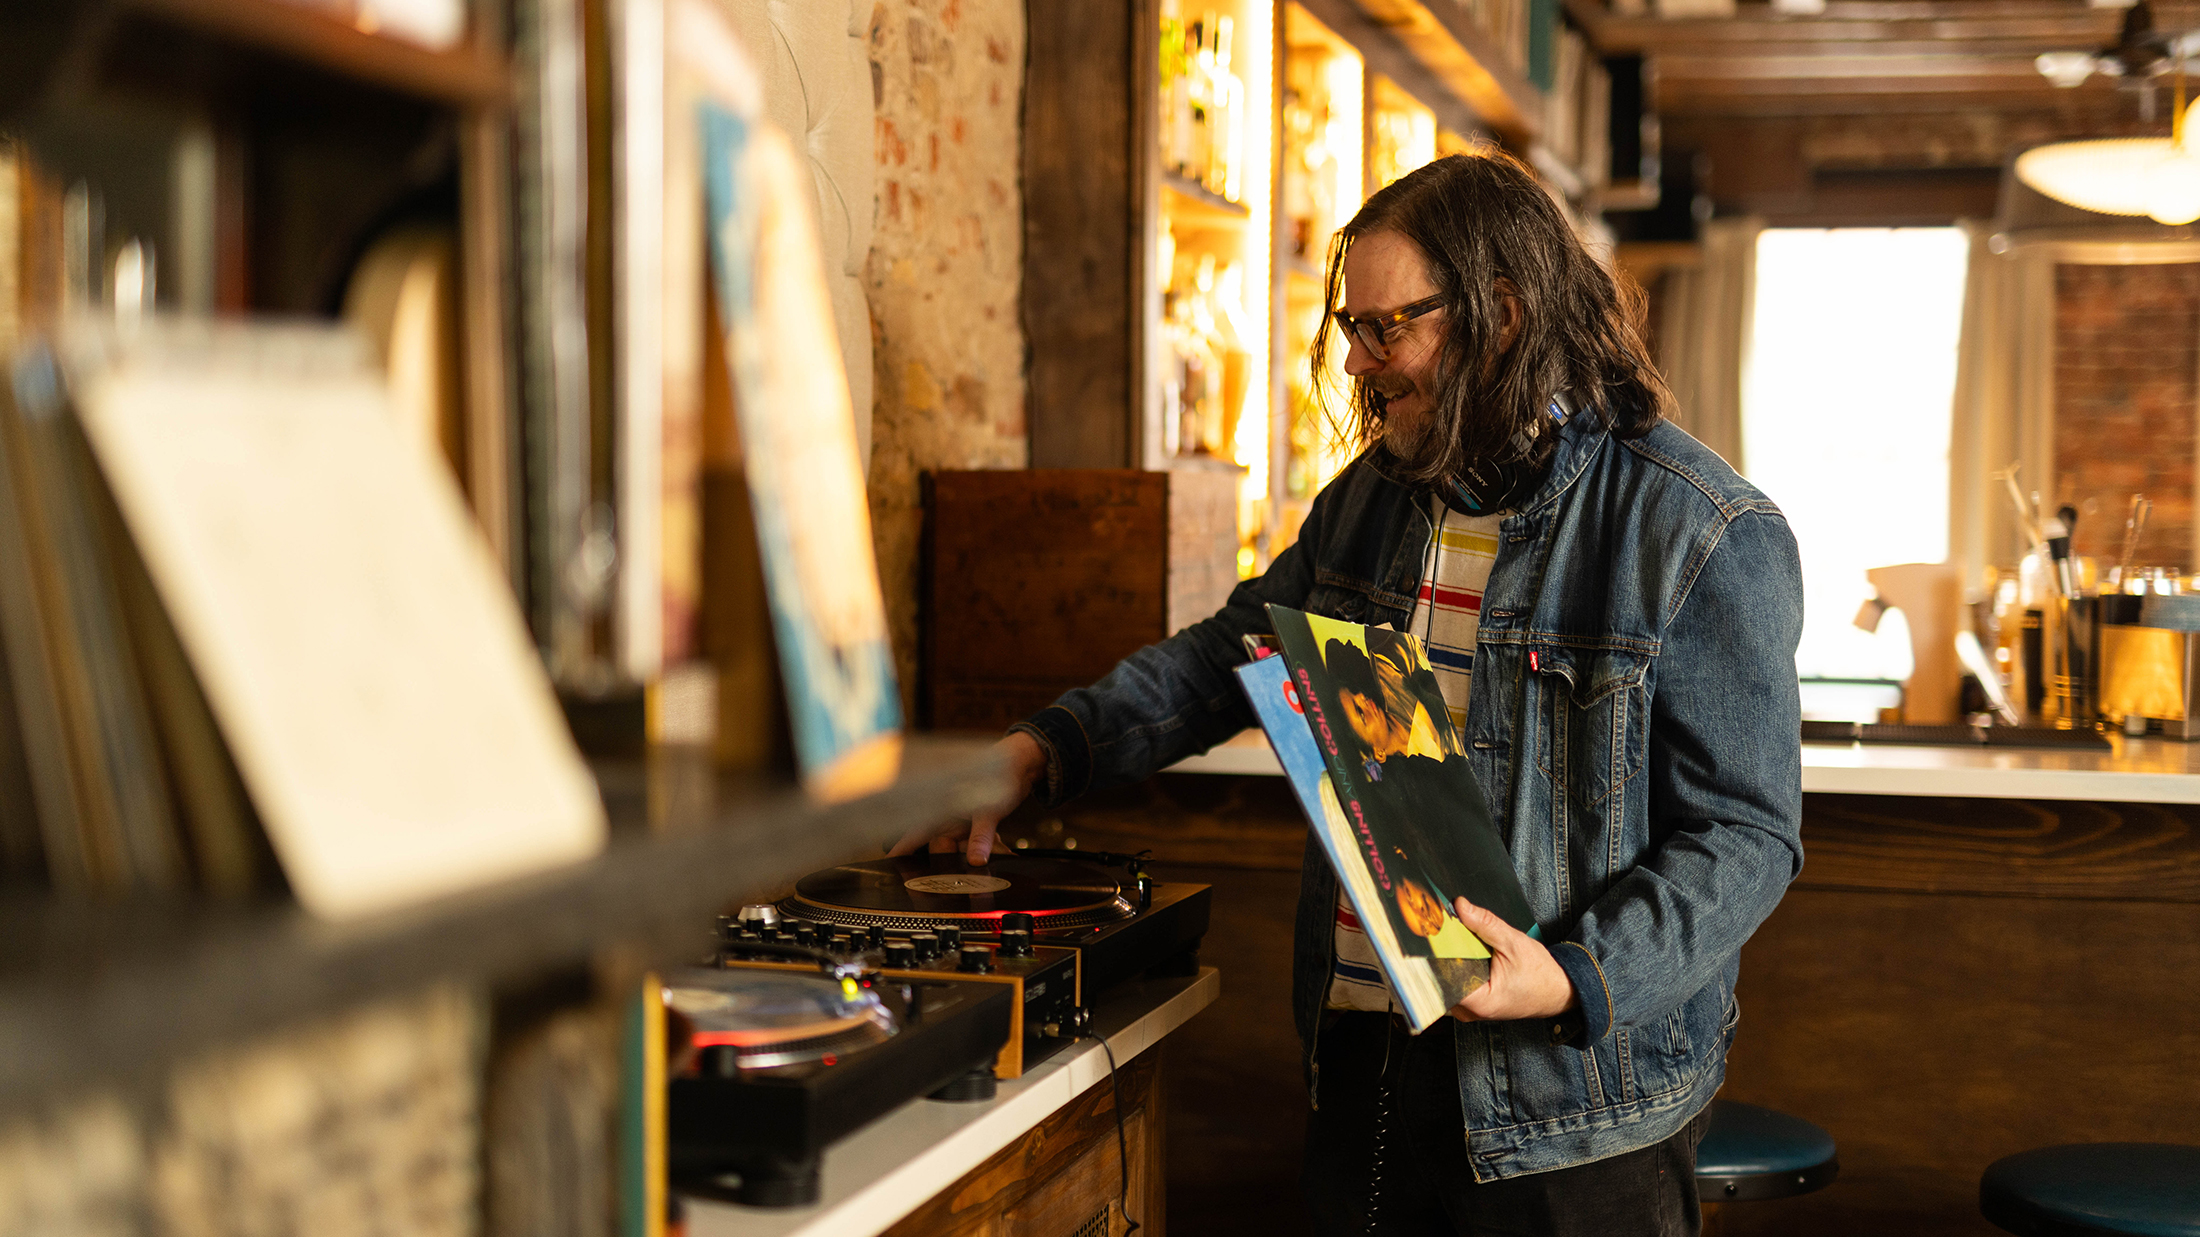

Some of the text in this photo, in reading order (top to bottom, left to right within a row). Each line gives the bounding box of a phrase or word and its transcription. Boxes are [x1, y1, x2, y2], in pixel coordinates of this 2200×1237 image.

[1467, 466, 1488, 487] SONY
[1297, 667, 1391, 891] COLLINS AND COLLINS
